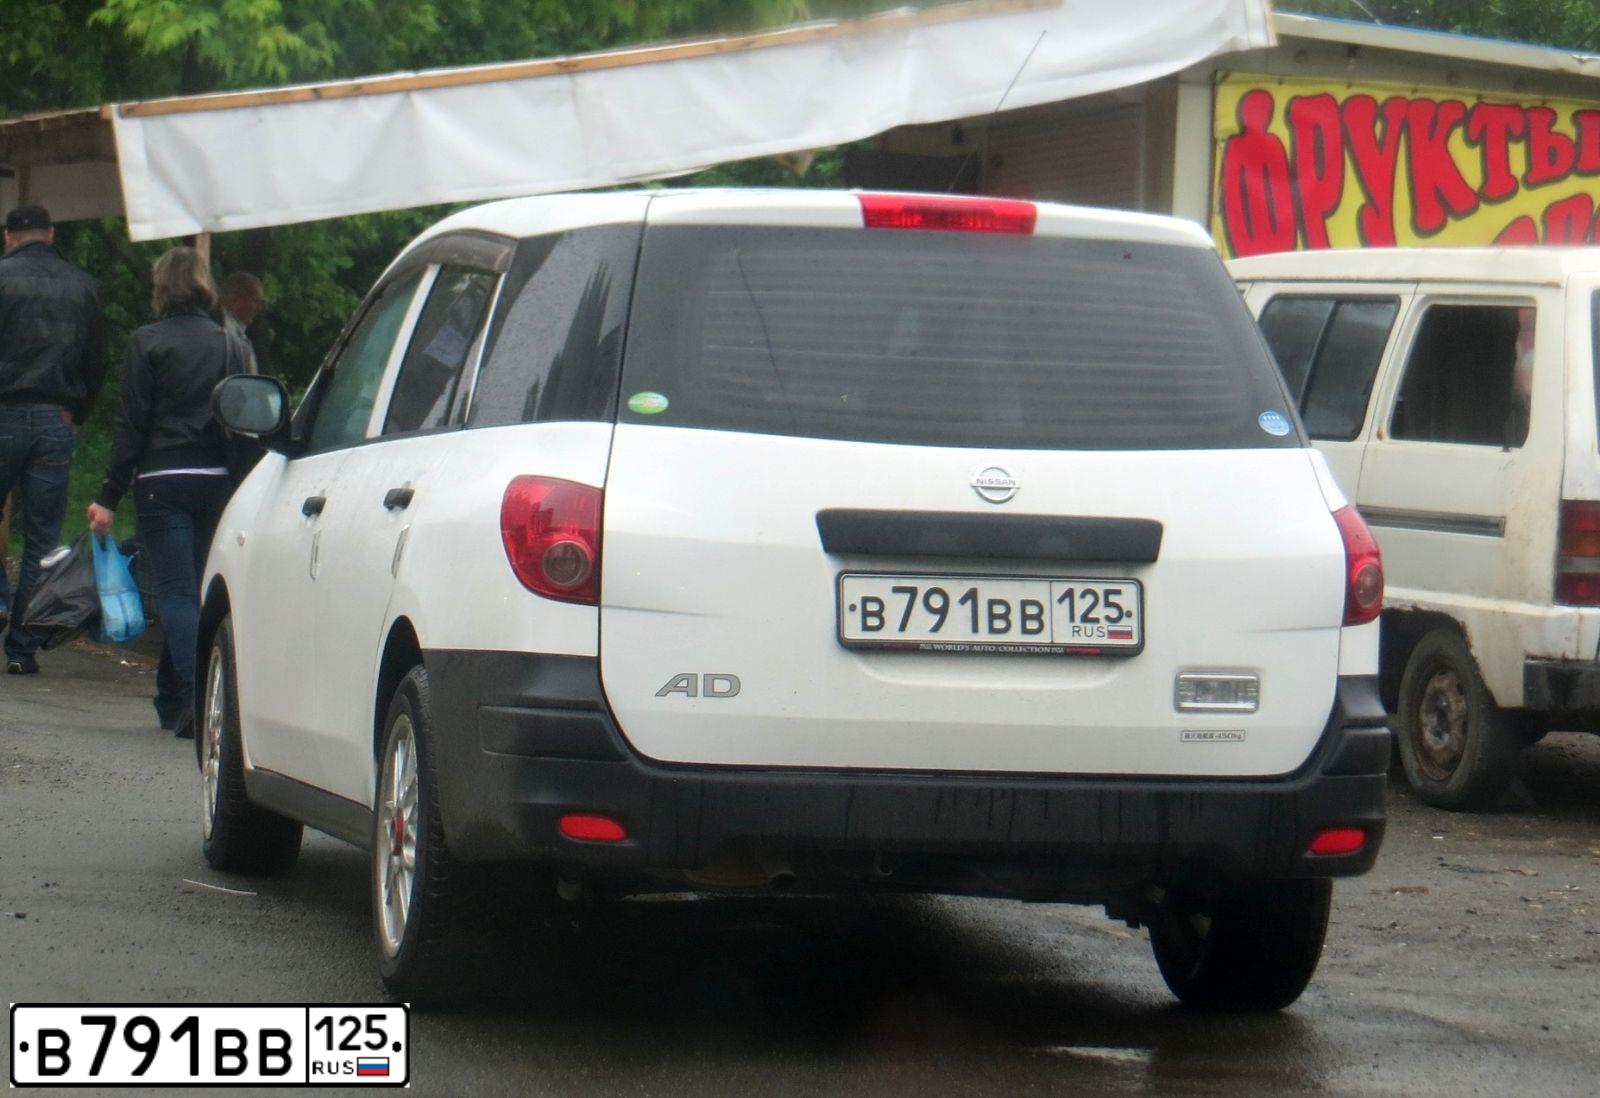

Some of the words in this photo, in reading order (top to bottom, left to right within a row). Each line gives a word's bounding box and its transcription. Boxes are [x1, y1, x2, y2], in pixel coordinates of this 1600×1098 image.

[1222, 89, 1600, 258] ФРУКТЫ
[976, 477, 1016, 485] NISSAN
[1057, 587, 1124, 624] 125
[1072, 625, 1106, 638] RUS
[973, 644, 996, 652] AUTO
[998, 645, 1050, 653] COLLECTION
[655, 673, 741, 698] AD
